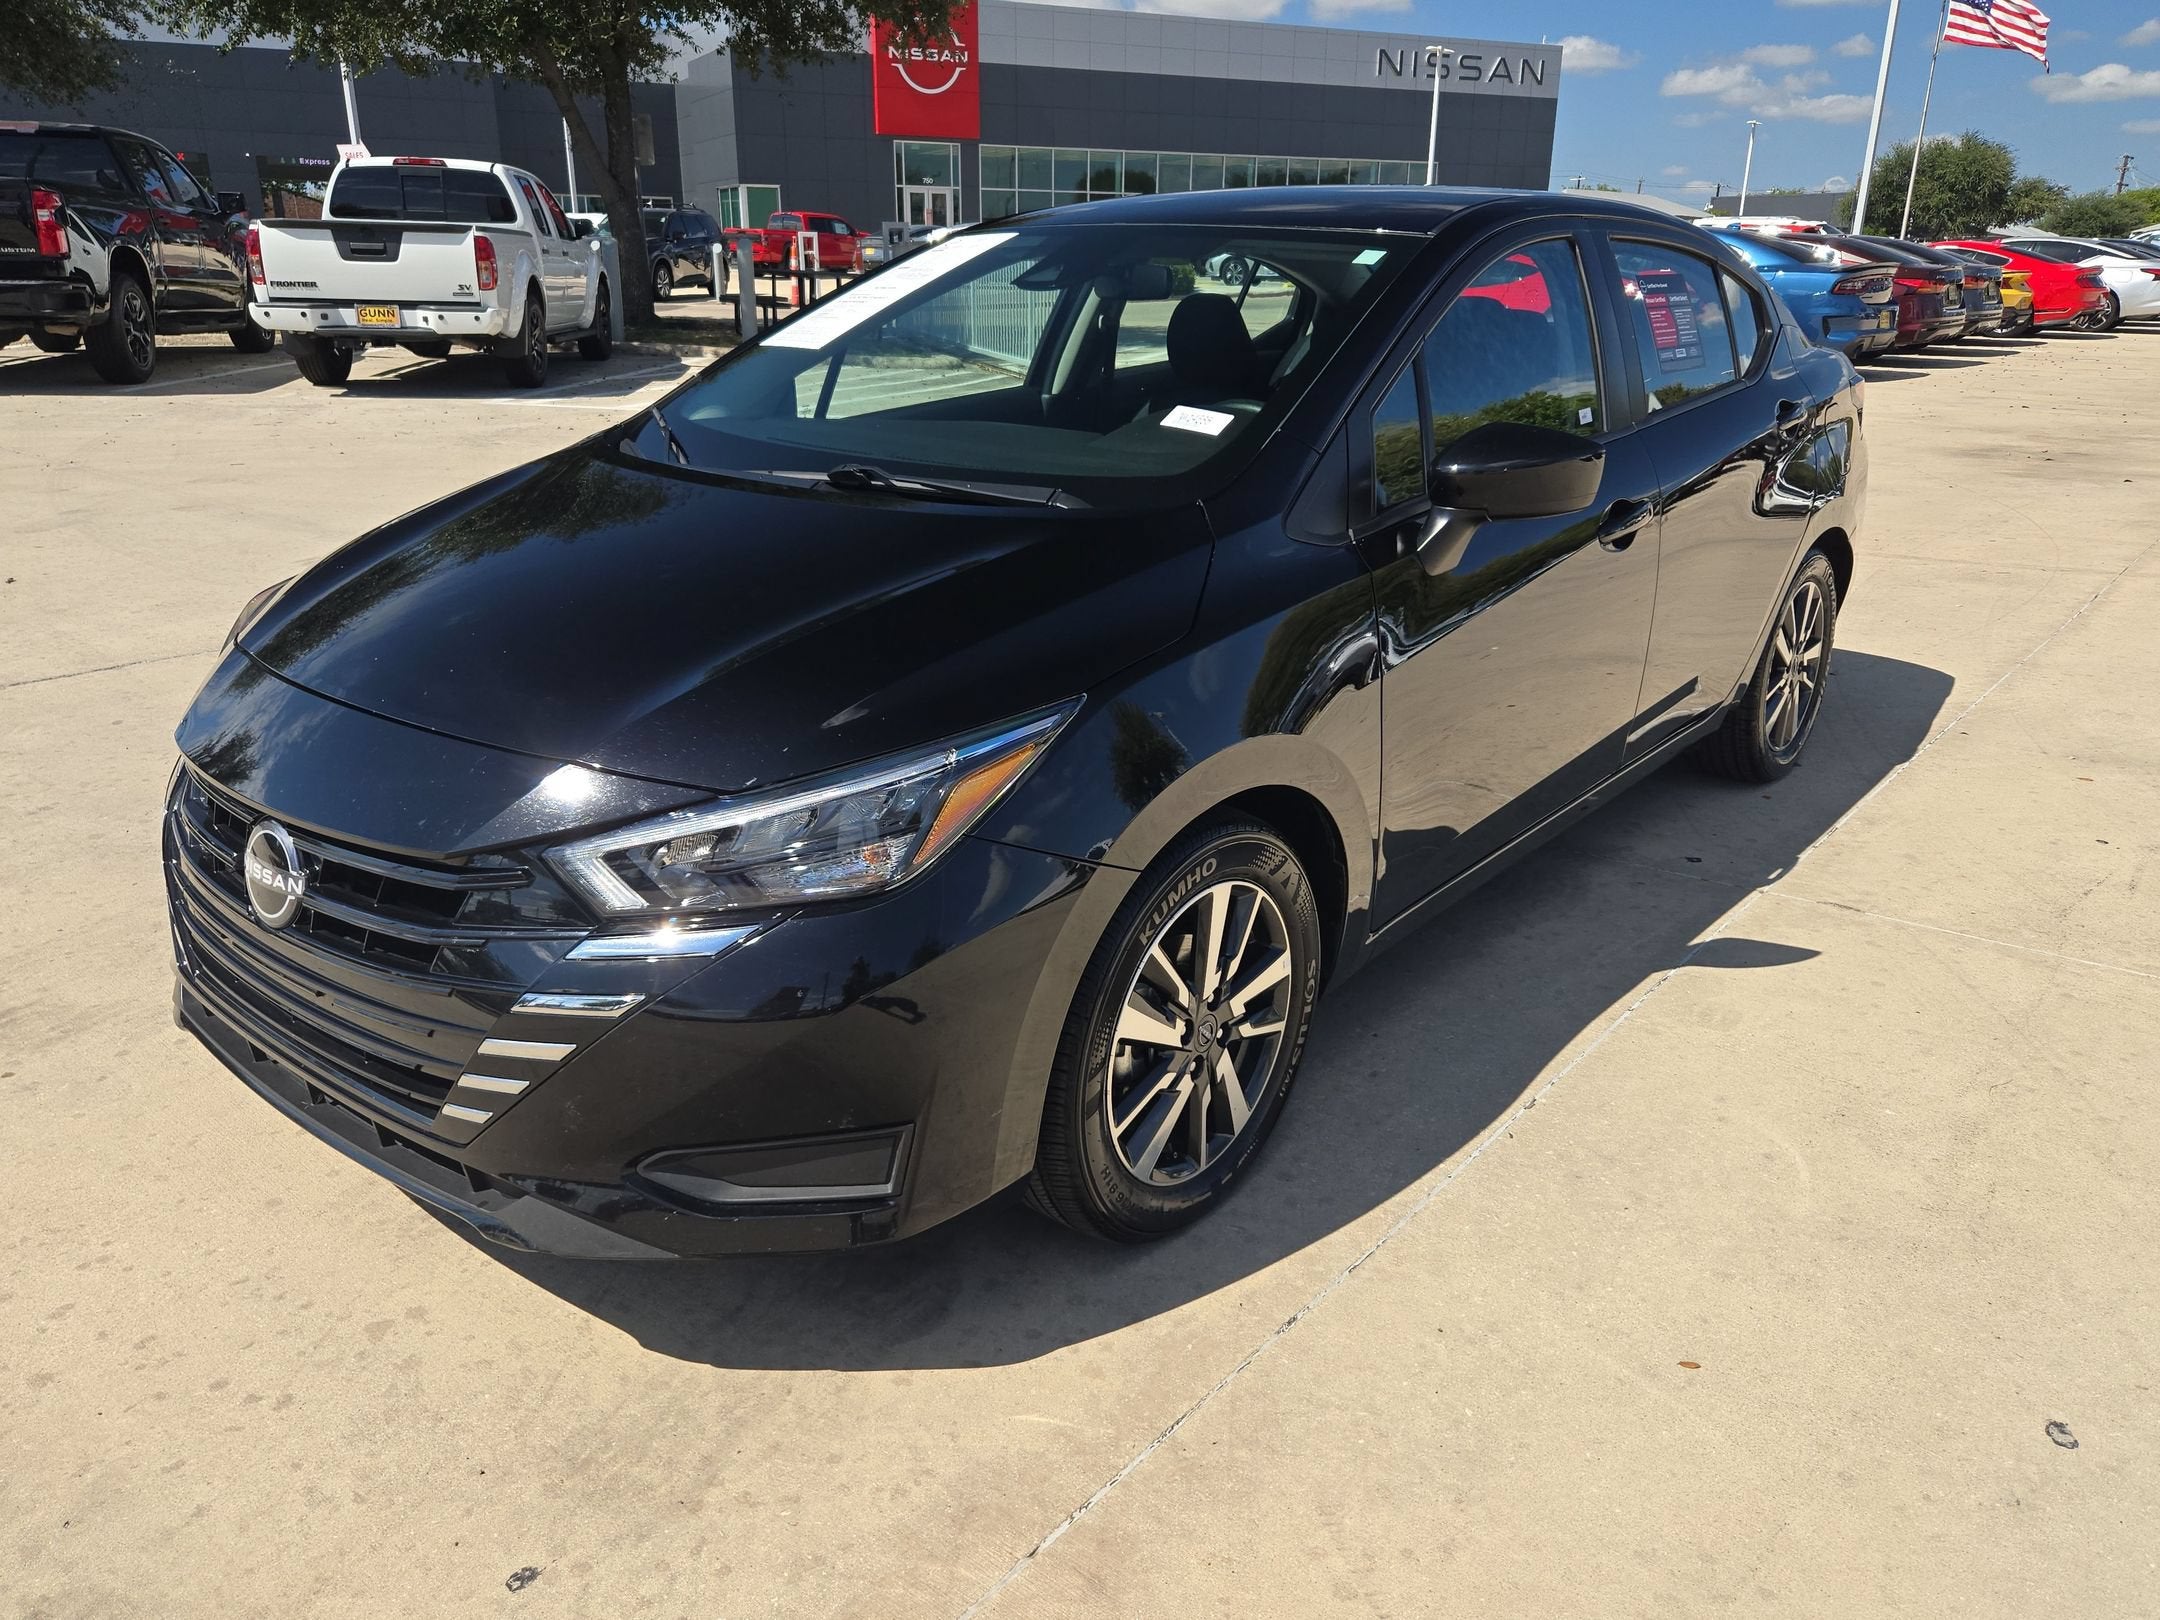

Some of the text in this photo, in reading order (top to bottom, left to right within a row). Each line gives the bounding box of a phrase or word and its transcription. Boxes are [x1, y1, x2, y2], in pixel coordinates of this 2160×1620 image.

[888, 46, 968, 63] NISSAN
[1376, 48, 1545, 86] NISSAN
[299, 157, 331, 166] Express
[344, 151, 364, 160] SALES
[270, 280, 319, 288] FRONTIER
[360, 309, 396, 318] GUNN
[1140, 858, 1217, 945] KUMHO
[1292, 959, 1317, 1065] SOLUS
